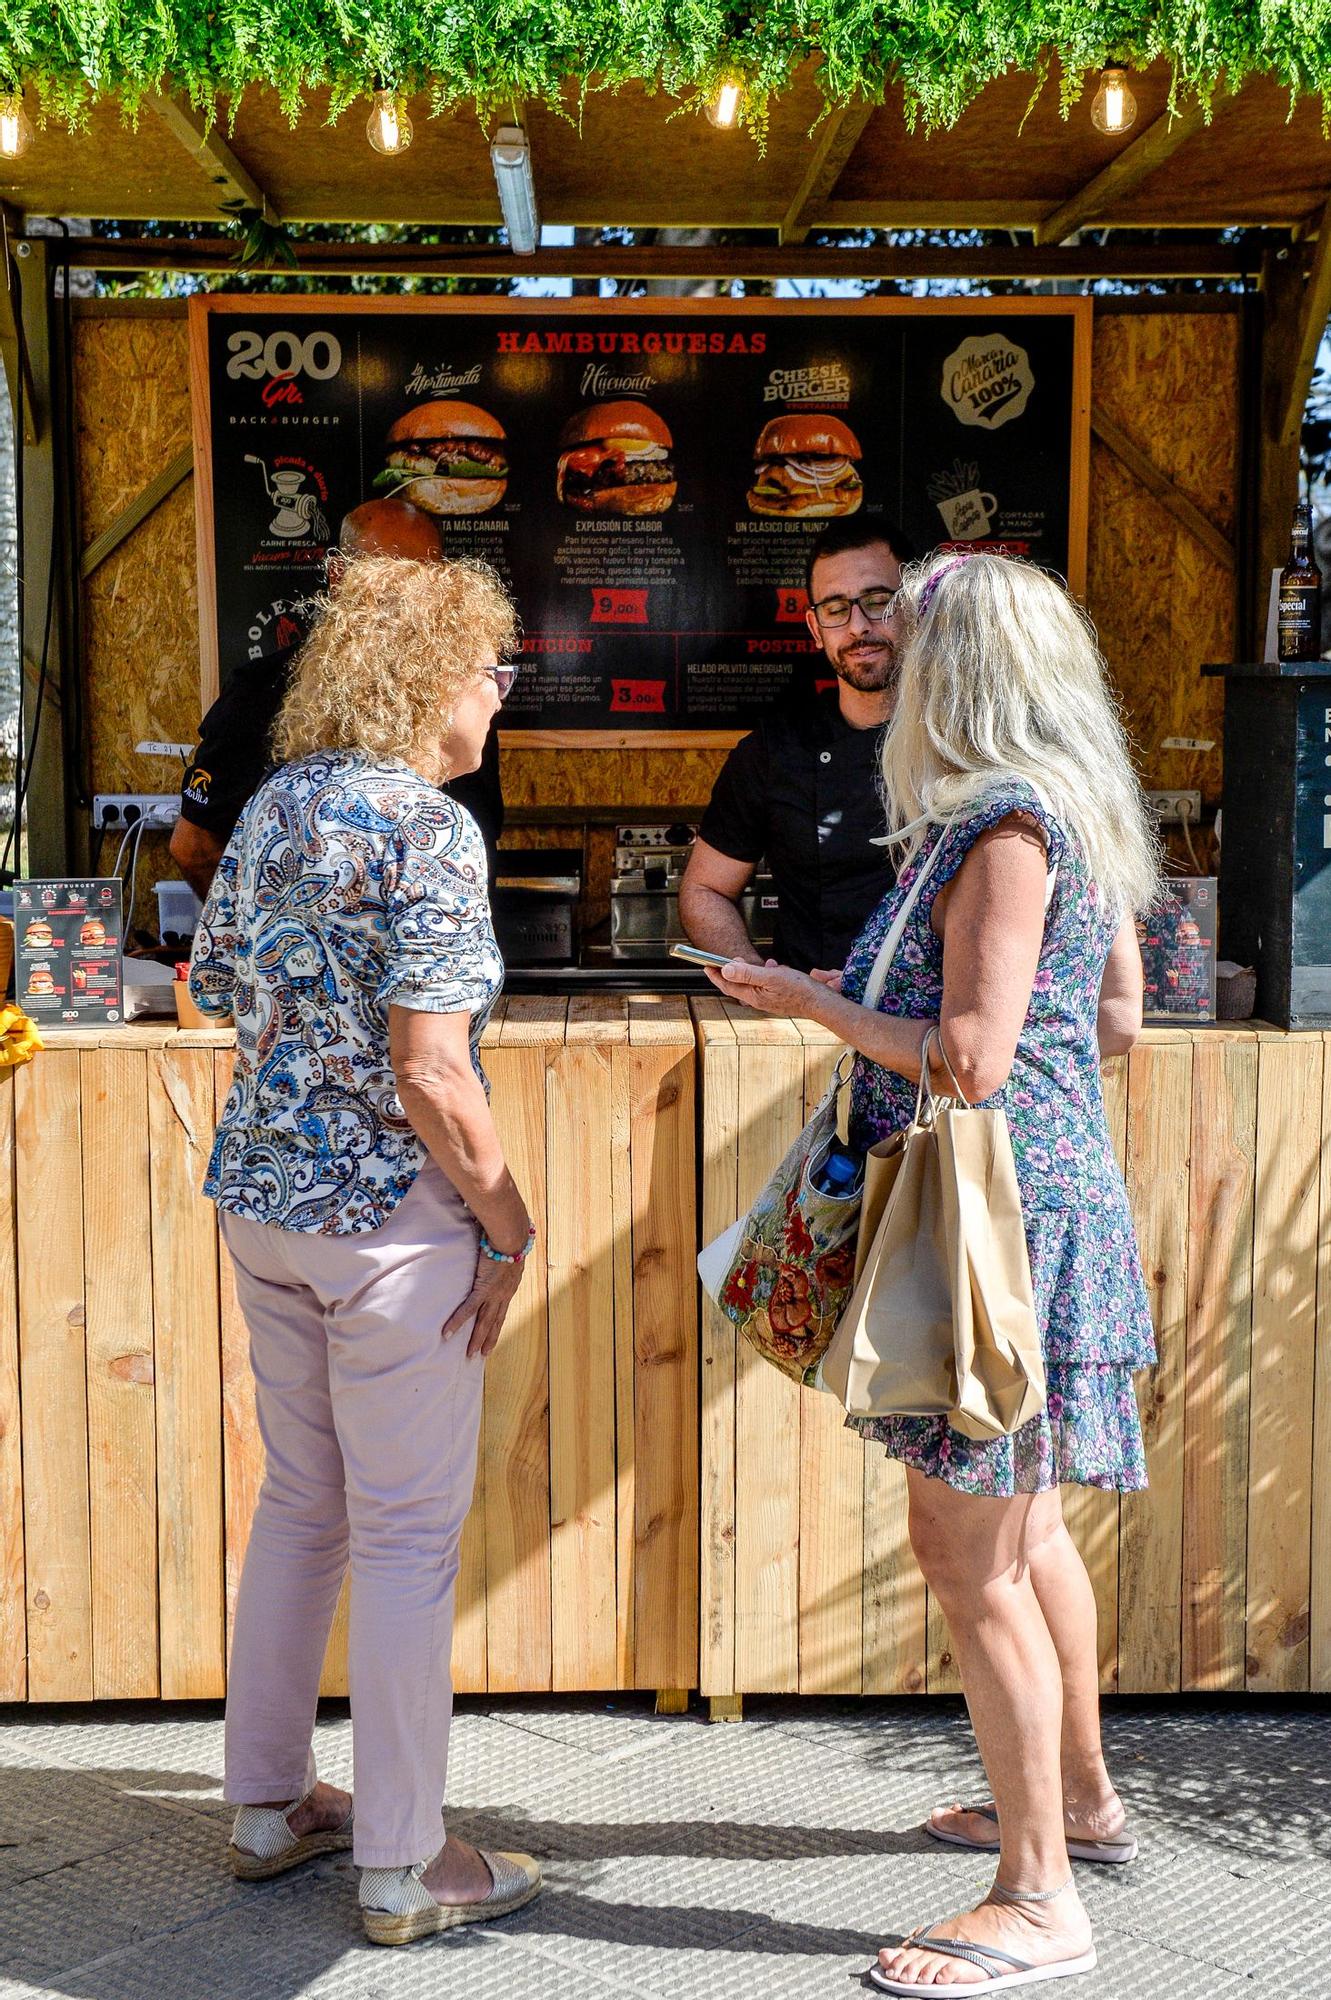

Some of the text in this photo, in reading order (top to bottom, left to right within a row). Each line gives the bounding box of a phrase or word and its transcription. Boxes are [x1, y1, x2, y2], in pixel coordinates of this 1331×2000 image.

[497, 332, 767, 353] HAMBURGUESAS
[226, 331, 342, 380] 200
[404, 364, 483, 396] Afortunada
[769, 364, 842, 386] CHEESE
[763, 376, 850, 402] BURGER
[968, 373, 1020, 409] 100%
[230, 416, 267, 425] BACK
[282, 416, 341, 425] BURGER
[454, 519, 472, 532] MÁS
[473, 519, 510, 532] CANARIA
[576, 519, 663, 533] EXPLOSIÓN DE SABOR
[735, 519, 747, 533] UN
[748, 519, 783, 533] CLÁSICO
[784, 519, 801, 533] QUE
[565, 536, 579, 545] Pan
[581, 536, 609, 545] brioche
[1279, 599, 1306, 613] special
[515, 637, 593, 654] NICIÓN
[687, 664, 716, 674] HELADO
[718, 664, 748, 674] POLVITO
[62, 1011, 79, 1019] 200
